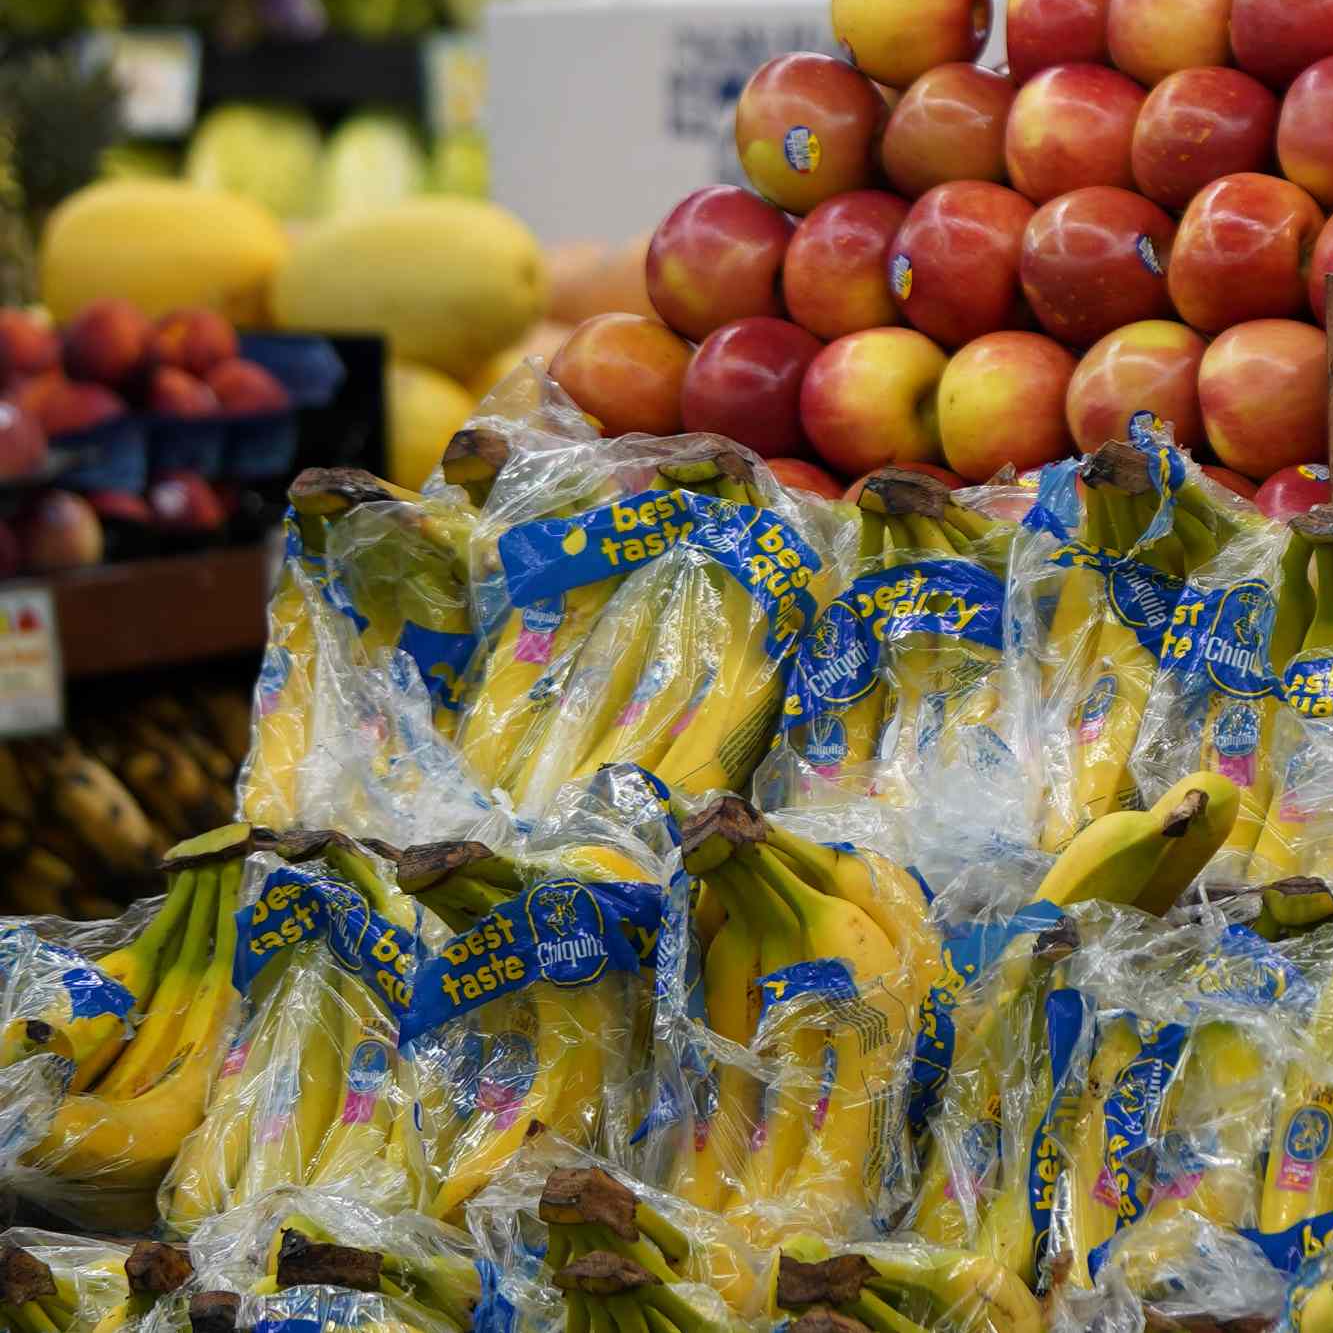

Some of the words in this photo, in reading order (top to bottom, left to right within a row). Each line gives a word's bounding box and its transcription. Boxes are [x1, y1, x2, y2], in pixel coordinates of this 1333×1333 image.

[757, 524, 814, 589] bes
[1122, 565, 1170, 629] hiquita
[807, 638, 870, 699] Chiquit
[1205, 635, 1263, 679] Chiq
[442, 953, 526, 1007] taste
[1035, 1125, 1058, 1211] bes
